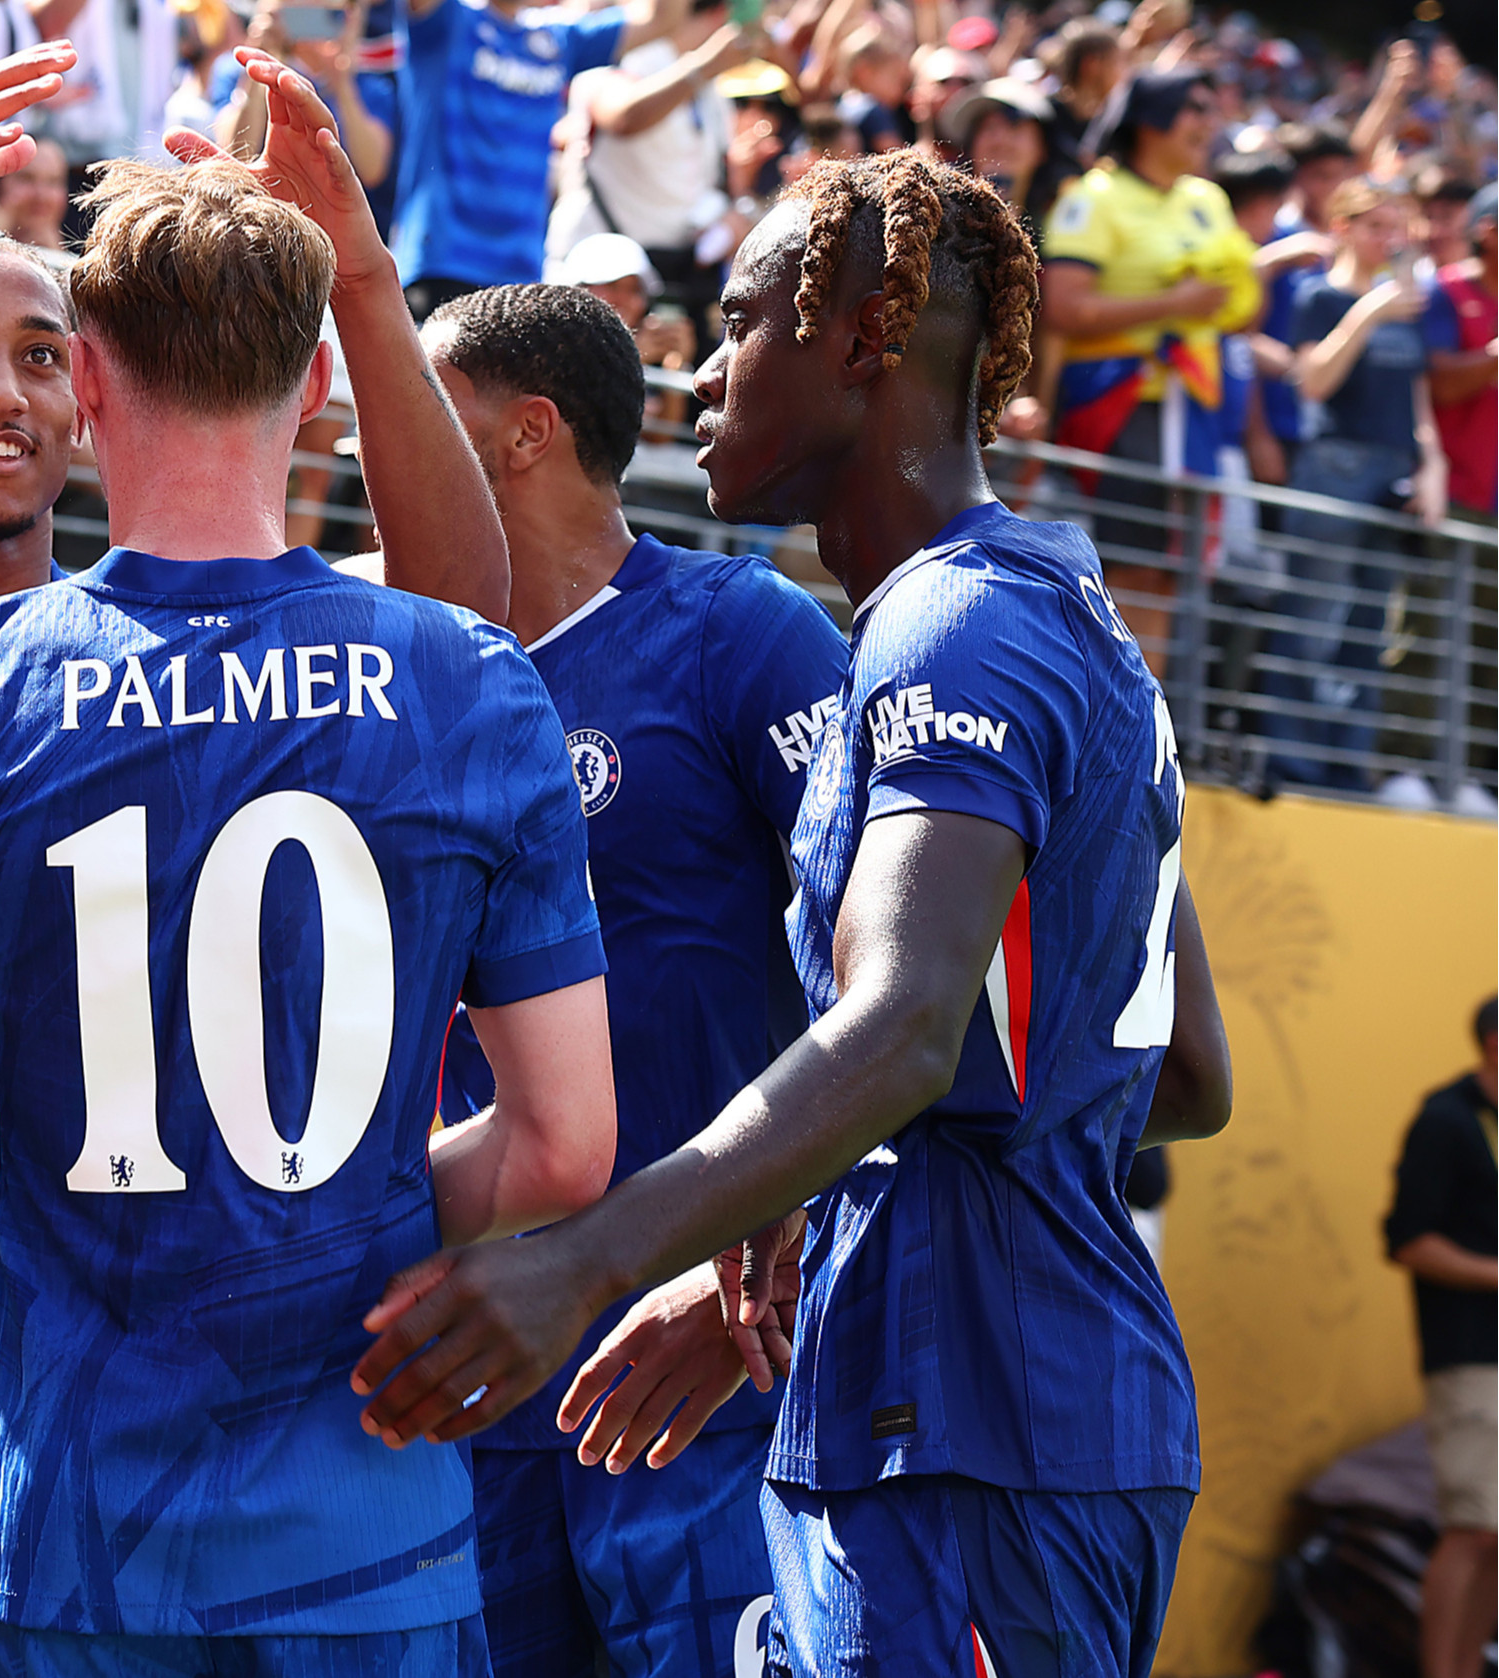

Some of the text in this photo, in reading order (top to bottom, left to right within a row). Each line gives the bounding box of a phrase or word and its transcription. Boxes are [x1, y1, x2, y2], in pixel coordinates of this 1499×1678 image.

[187, 615, 231, 628] CFC
[60, 643, 398, 730] PALMER
[867, 683, 935, 733] LIVE
[874, 711, 1008, 765] NATION
[46, 790, 395, 1193] 10
